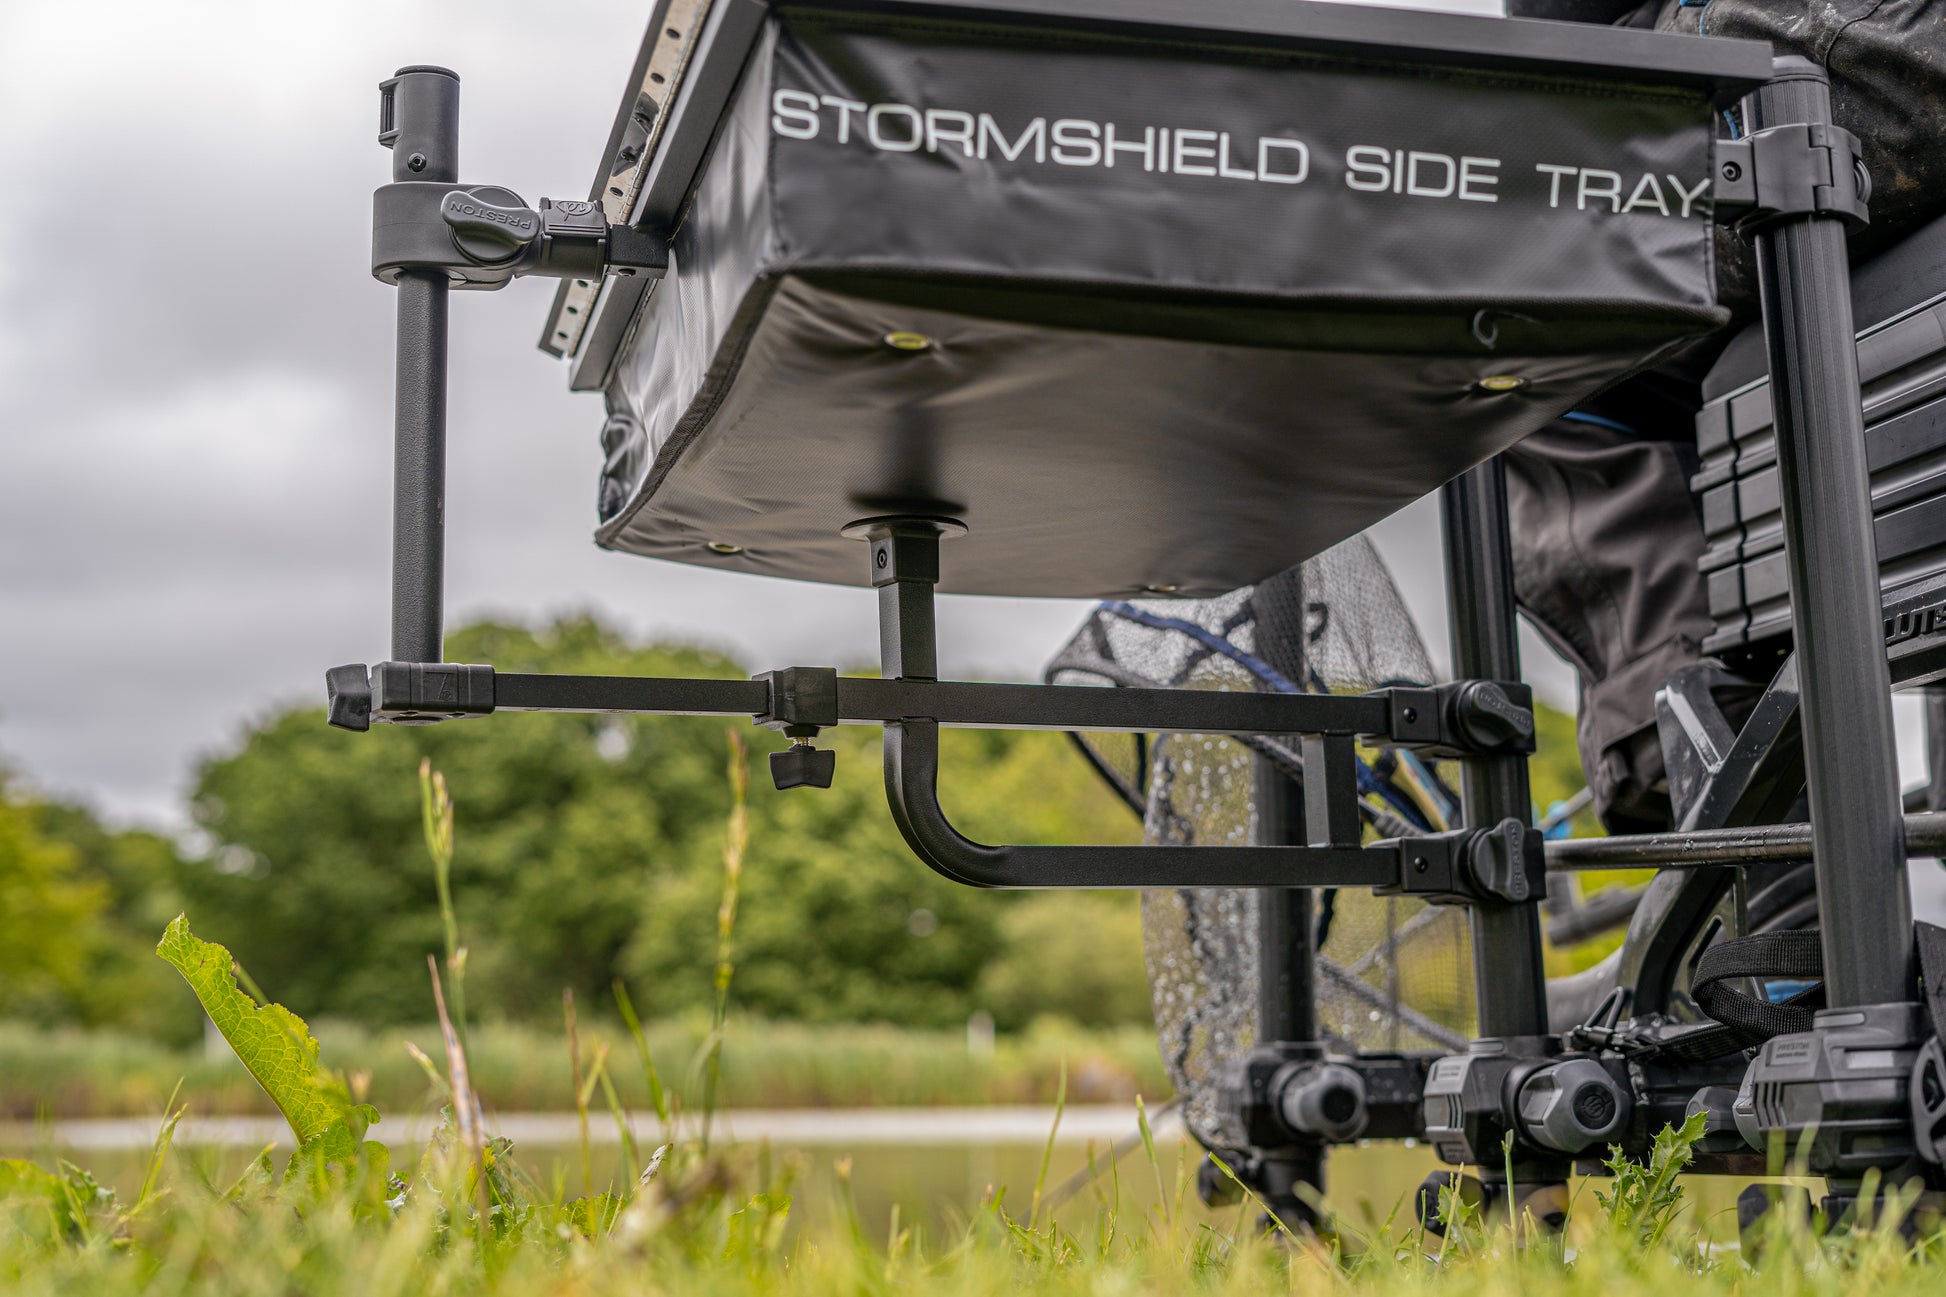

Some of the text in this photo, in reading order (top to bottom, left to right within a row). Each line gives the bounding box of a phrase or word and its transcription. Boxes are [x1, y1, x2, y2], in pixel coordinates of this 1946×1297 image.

[772, 88, 1712, 218] STORMSHIELD SIDE TRAY
[450, 200, 532, 230] PRESTON
